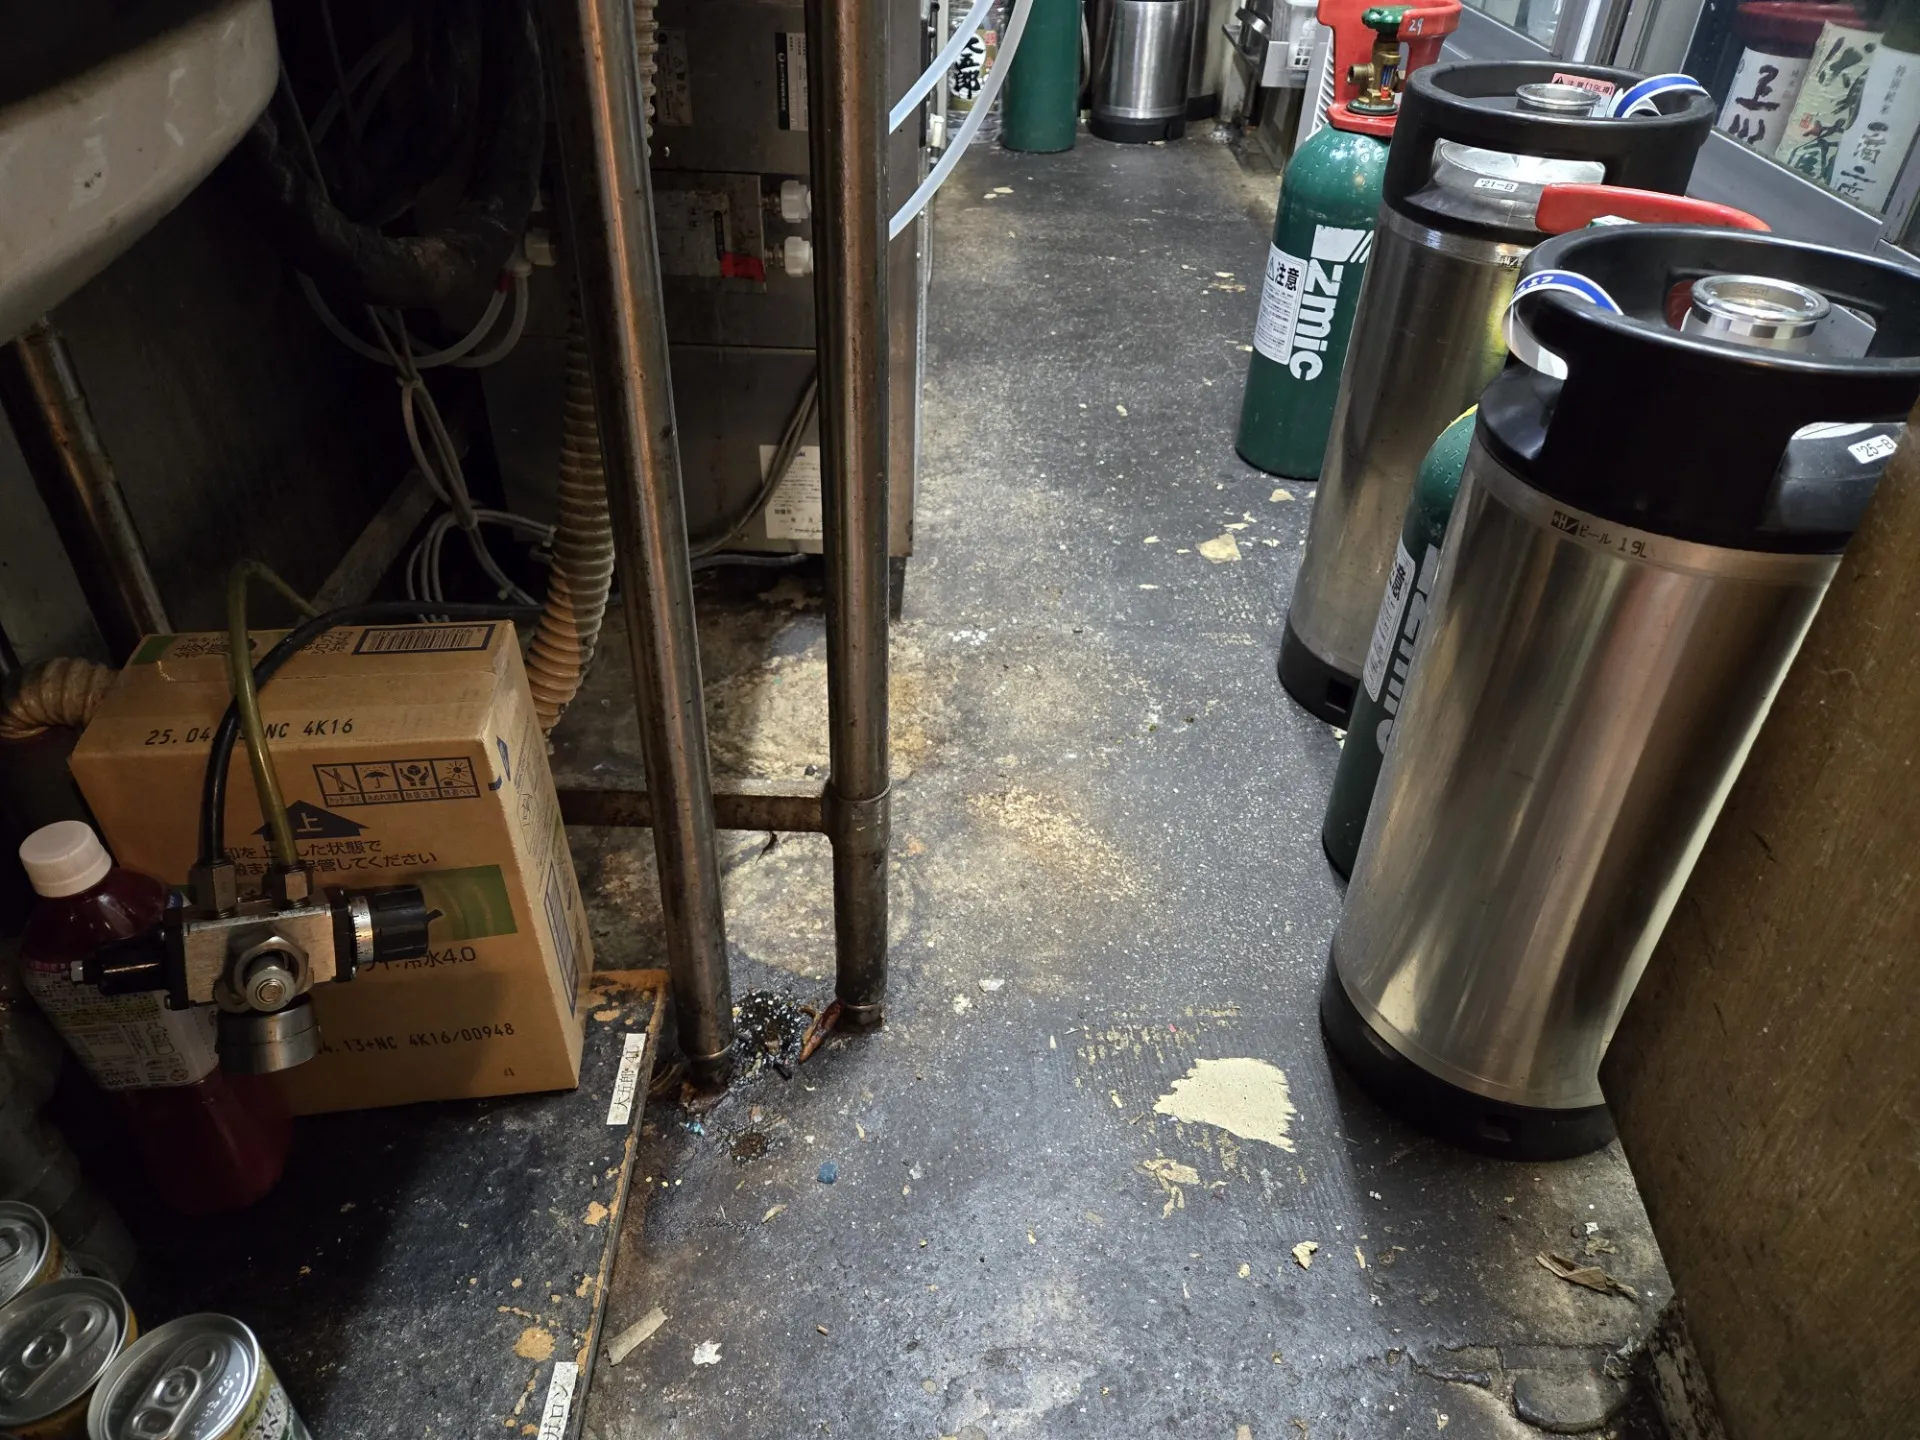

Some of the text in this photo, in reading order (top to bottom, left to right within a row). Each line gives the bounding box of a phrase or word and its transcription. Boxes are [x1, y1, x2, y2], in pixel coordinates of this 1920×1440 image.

[1274, 261, 1300, 292] 注意
[1618, 537, 1648, 558] 19L
[303, 718, 354, 736] 4K16
[296, 813, 324, 833] 上
[225, 840, 382, 860] 印を上した状態で
[317, 1035, 398, 1055] 4.13+NC
